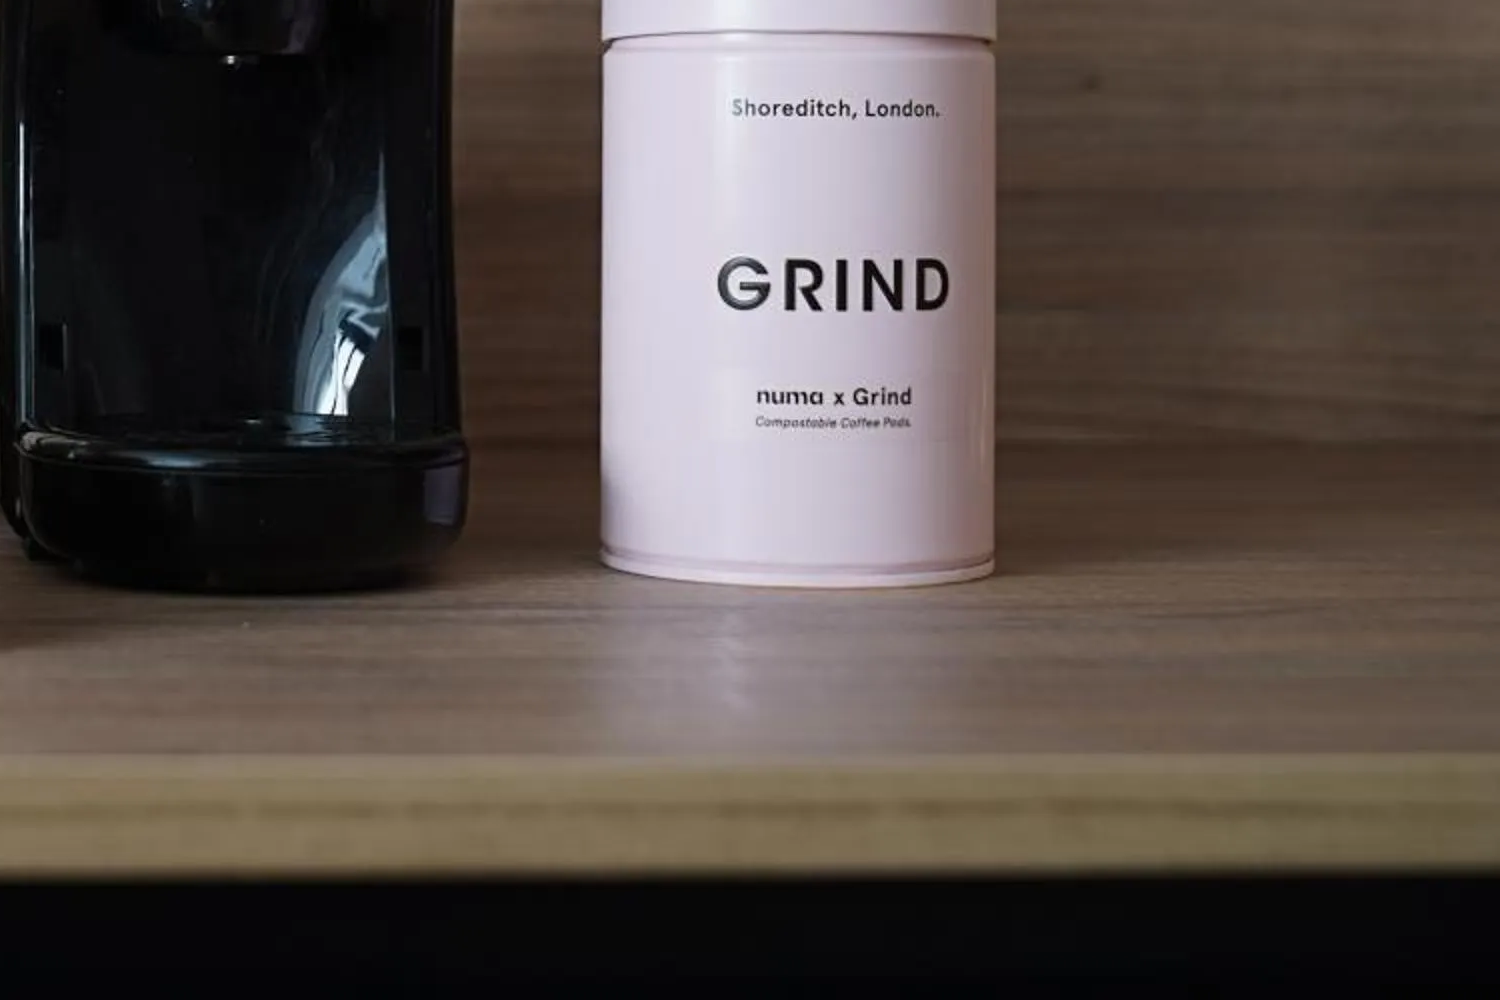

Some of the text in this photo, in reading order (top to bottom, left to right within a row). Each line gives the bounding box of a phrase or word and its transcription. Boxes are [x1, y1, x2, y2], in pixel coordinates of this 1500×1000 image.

[731, 98, 941, 119] Shoreditch, London.
[717, 256, 950, 311] GRIND
[757, 388, 912, 407] numa x Grind
[755, 415, 837, 429] Compostable
[841, 416, 880, 429] Coffee
